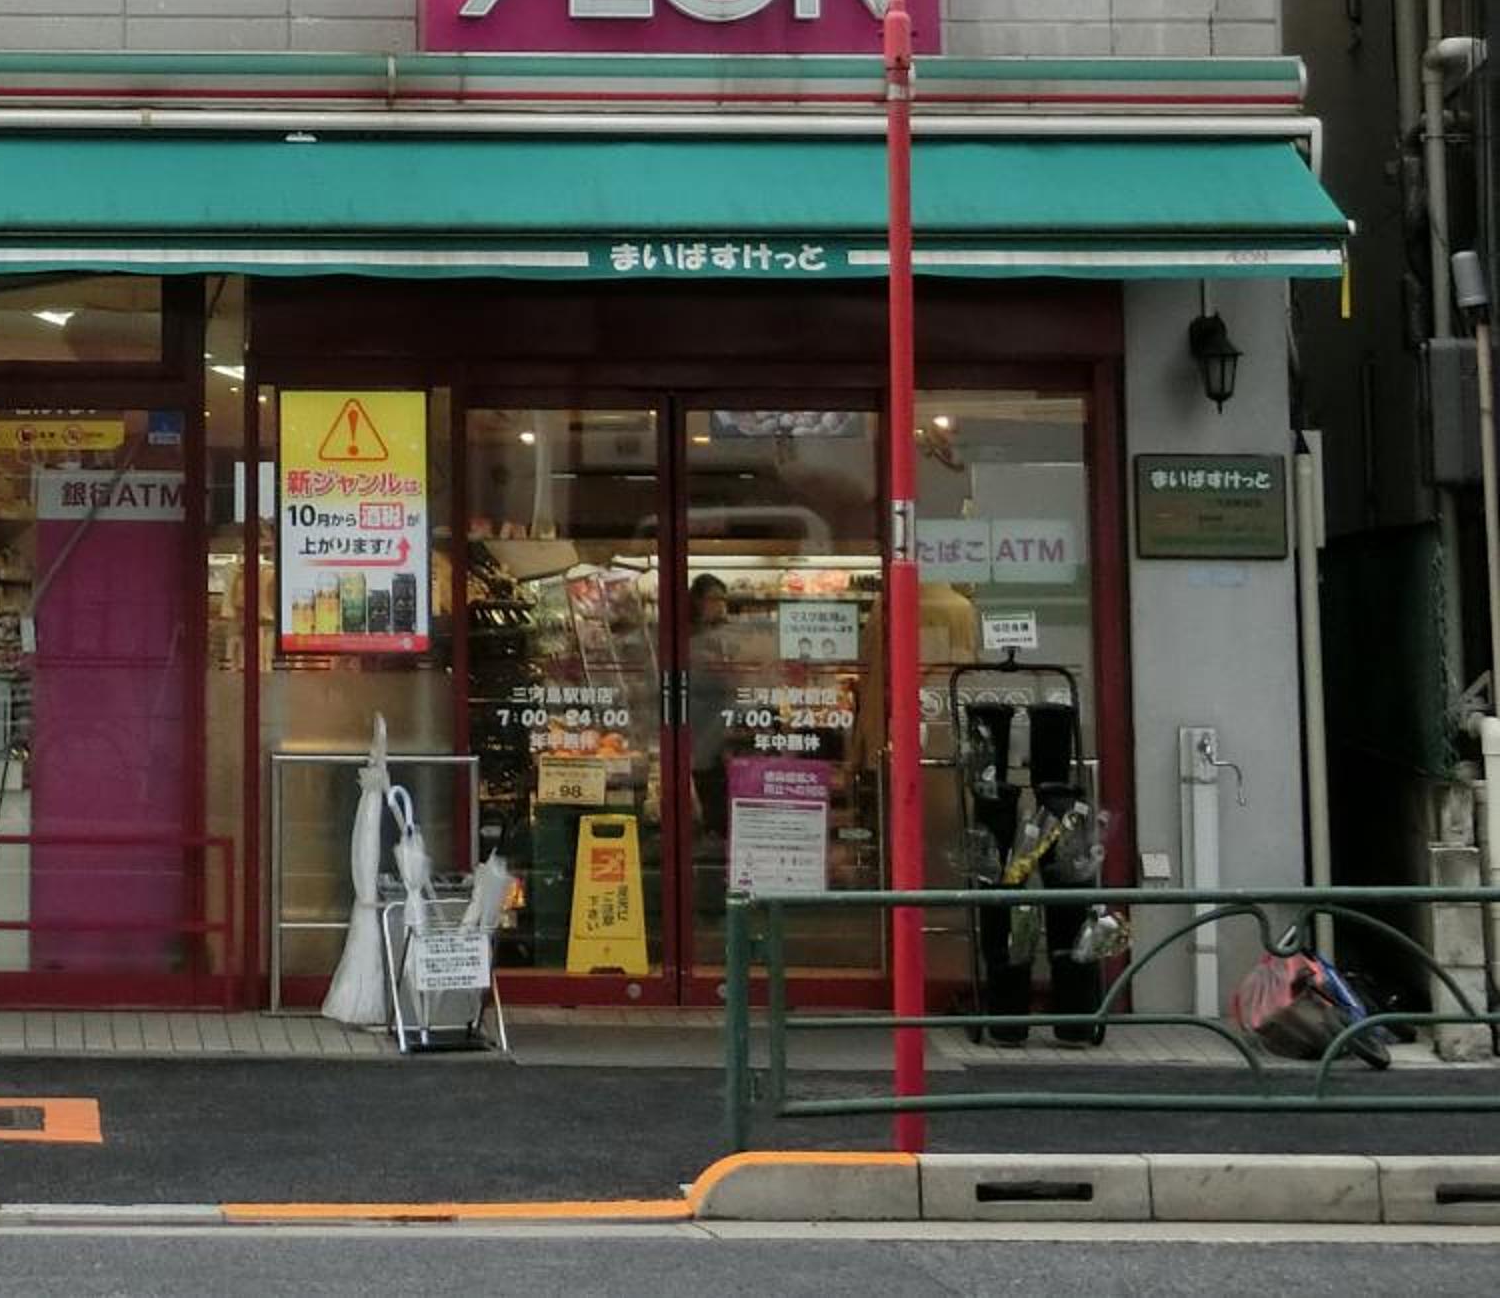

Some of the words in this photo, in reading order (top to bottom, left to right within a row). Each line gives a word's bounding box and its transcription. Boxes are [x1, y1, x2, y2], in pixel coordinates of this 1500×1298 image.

[610, 242, 827, 271] まいばすけっと
[1151, 469, 1271, 489] まいばすけっと
[61, 481, 182, 508] 銀行ATM
[996, 538, 1065, 562] ATM
